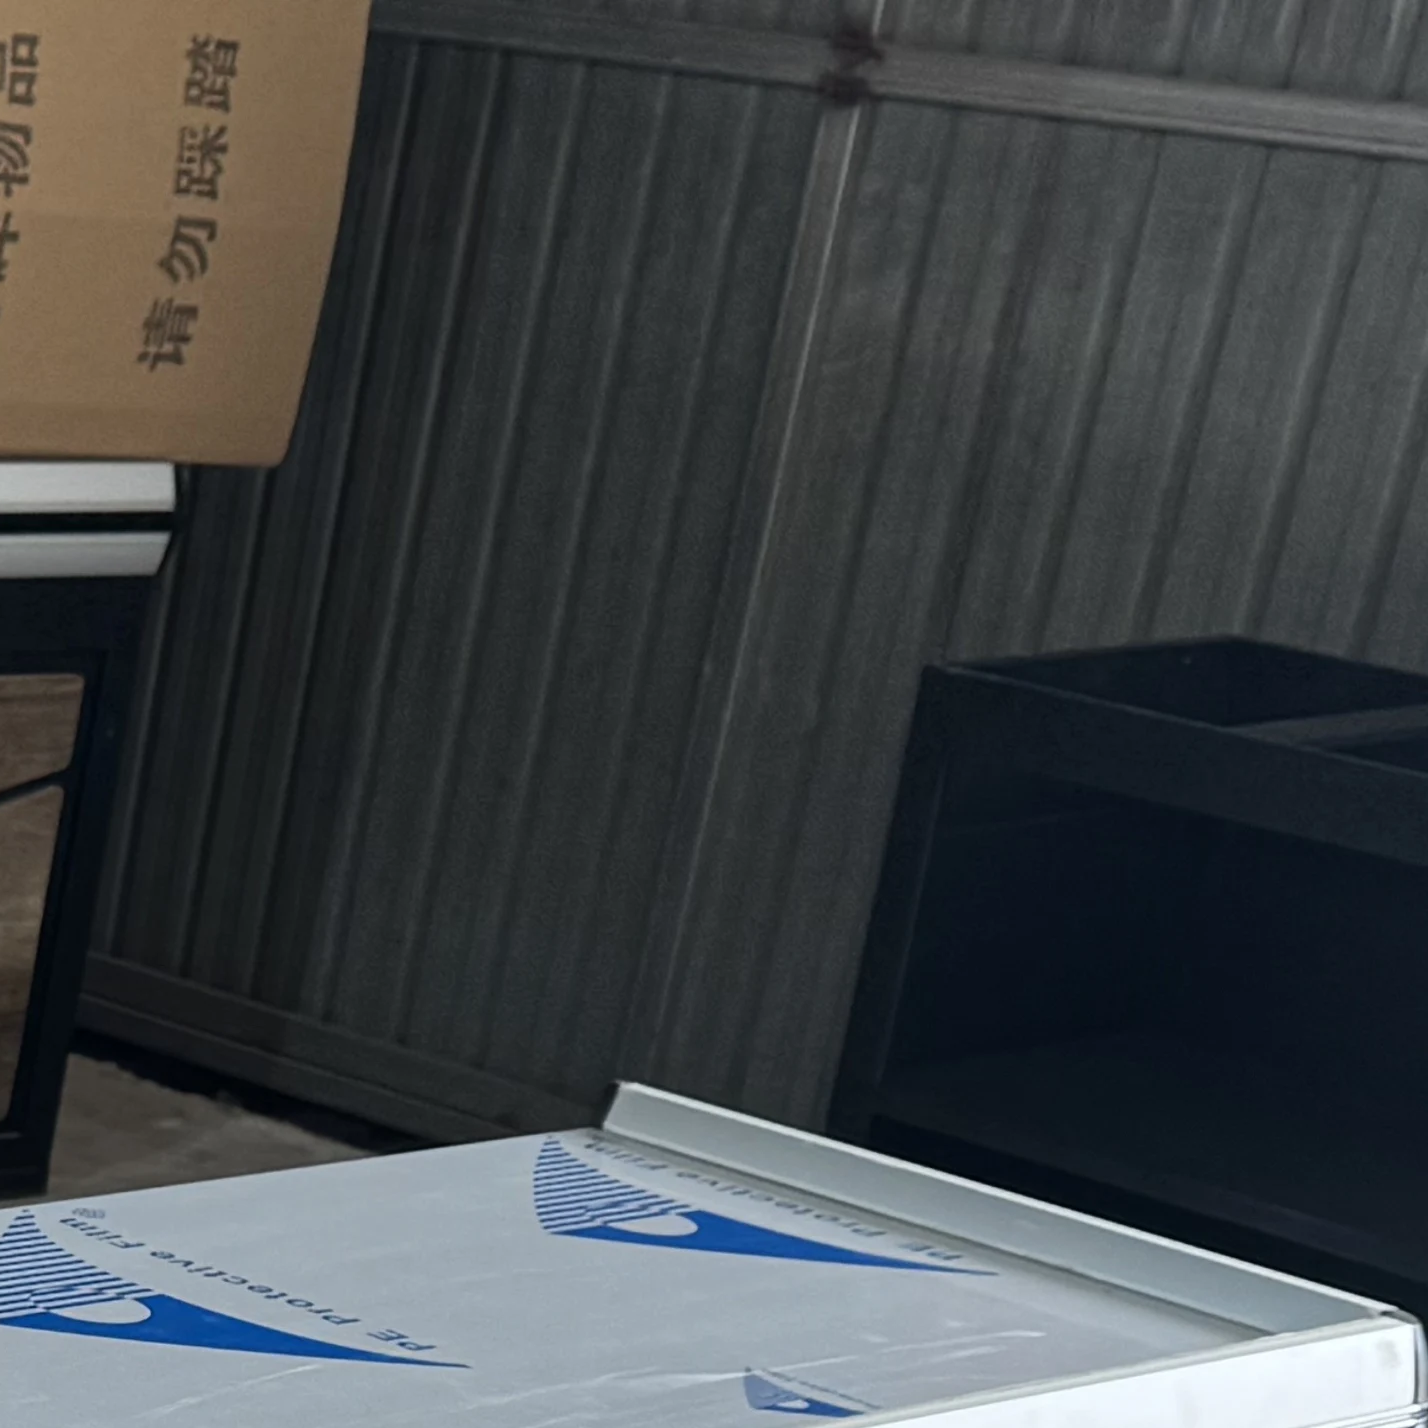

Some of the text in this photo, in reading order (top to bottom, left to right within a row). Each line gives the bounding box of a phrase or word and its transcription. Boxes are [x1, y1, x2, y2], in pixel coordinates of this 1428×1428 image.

[137, 35, 242, 372] 请勿踩踏
[59, 1216, 437, 1352] PE Protective Film
